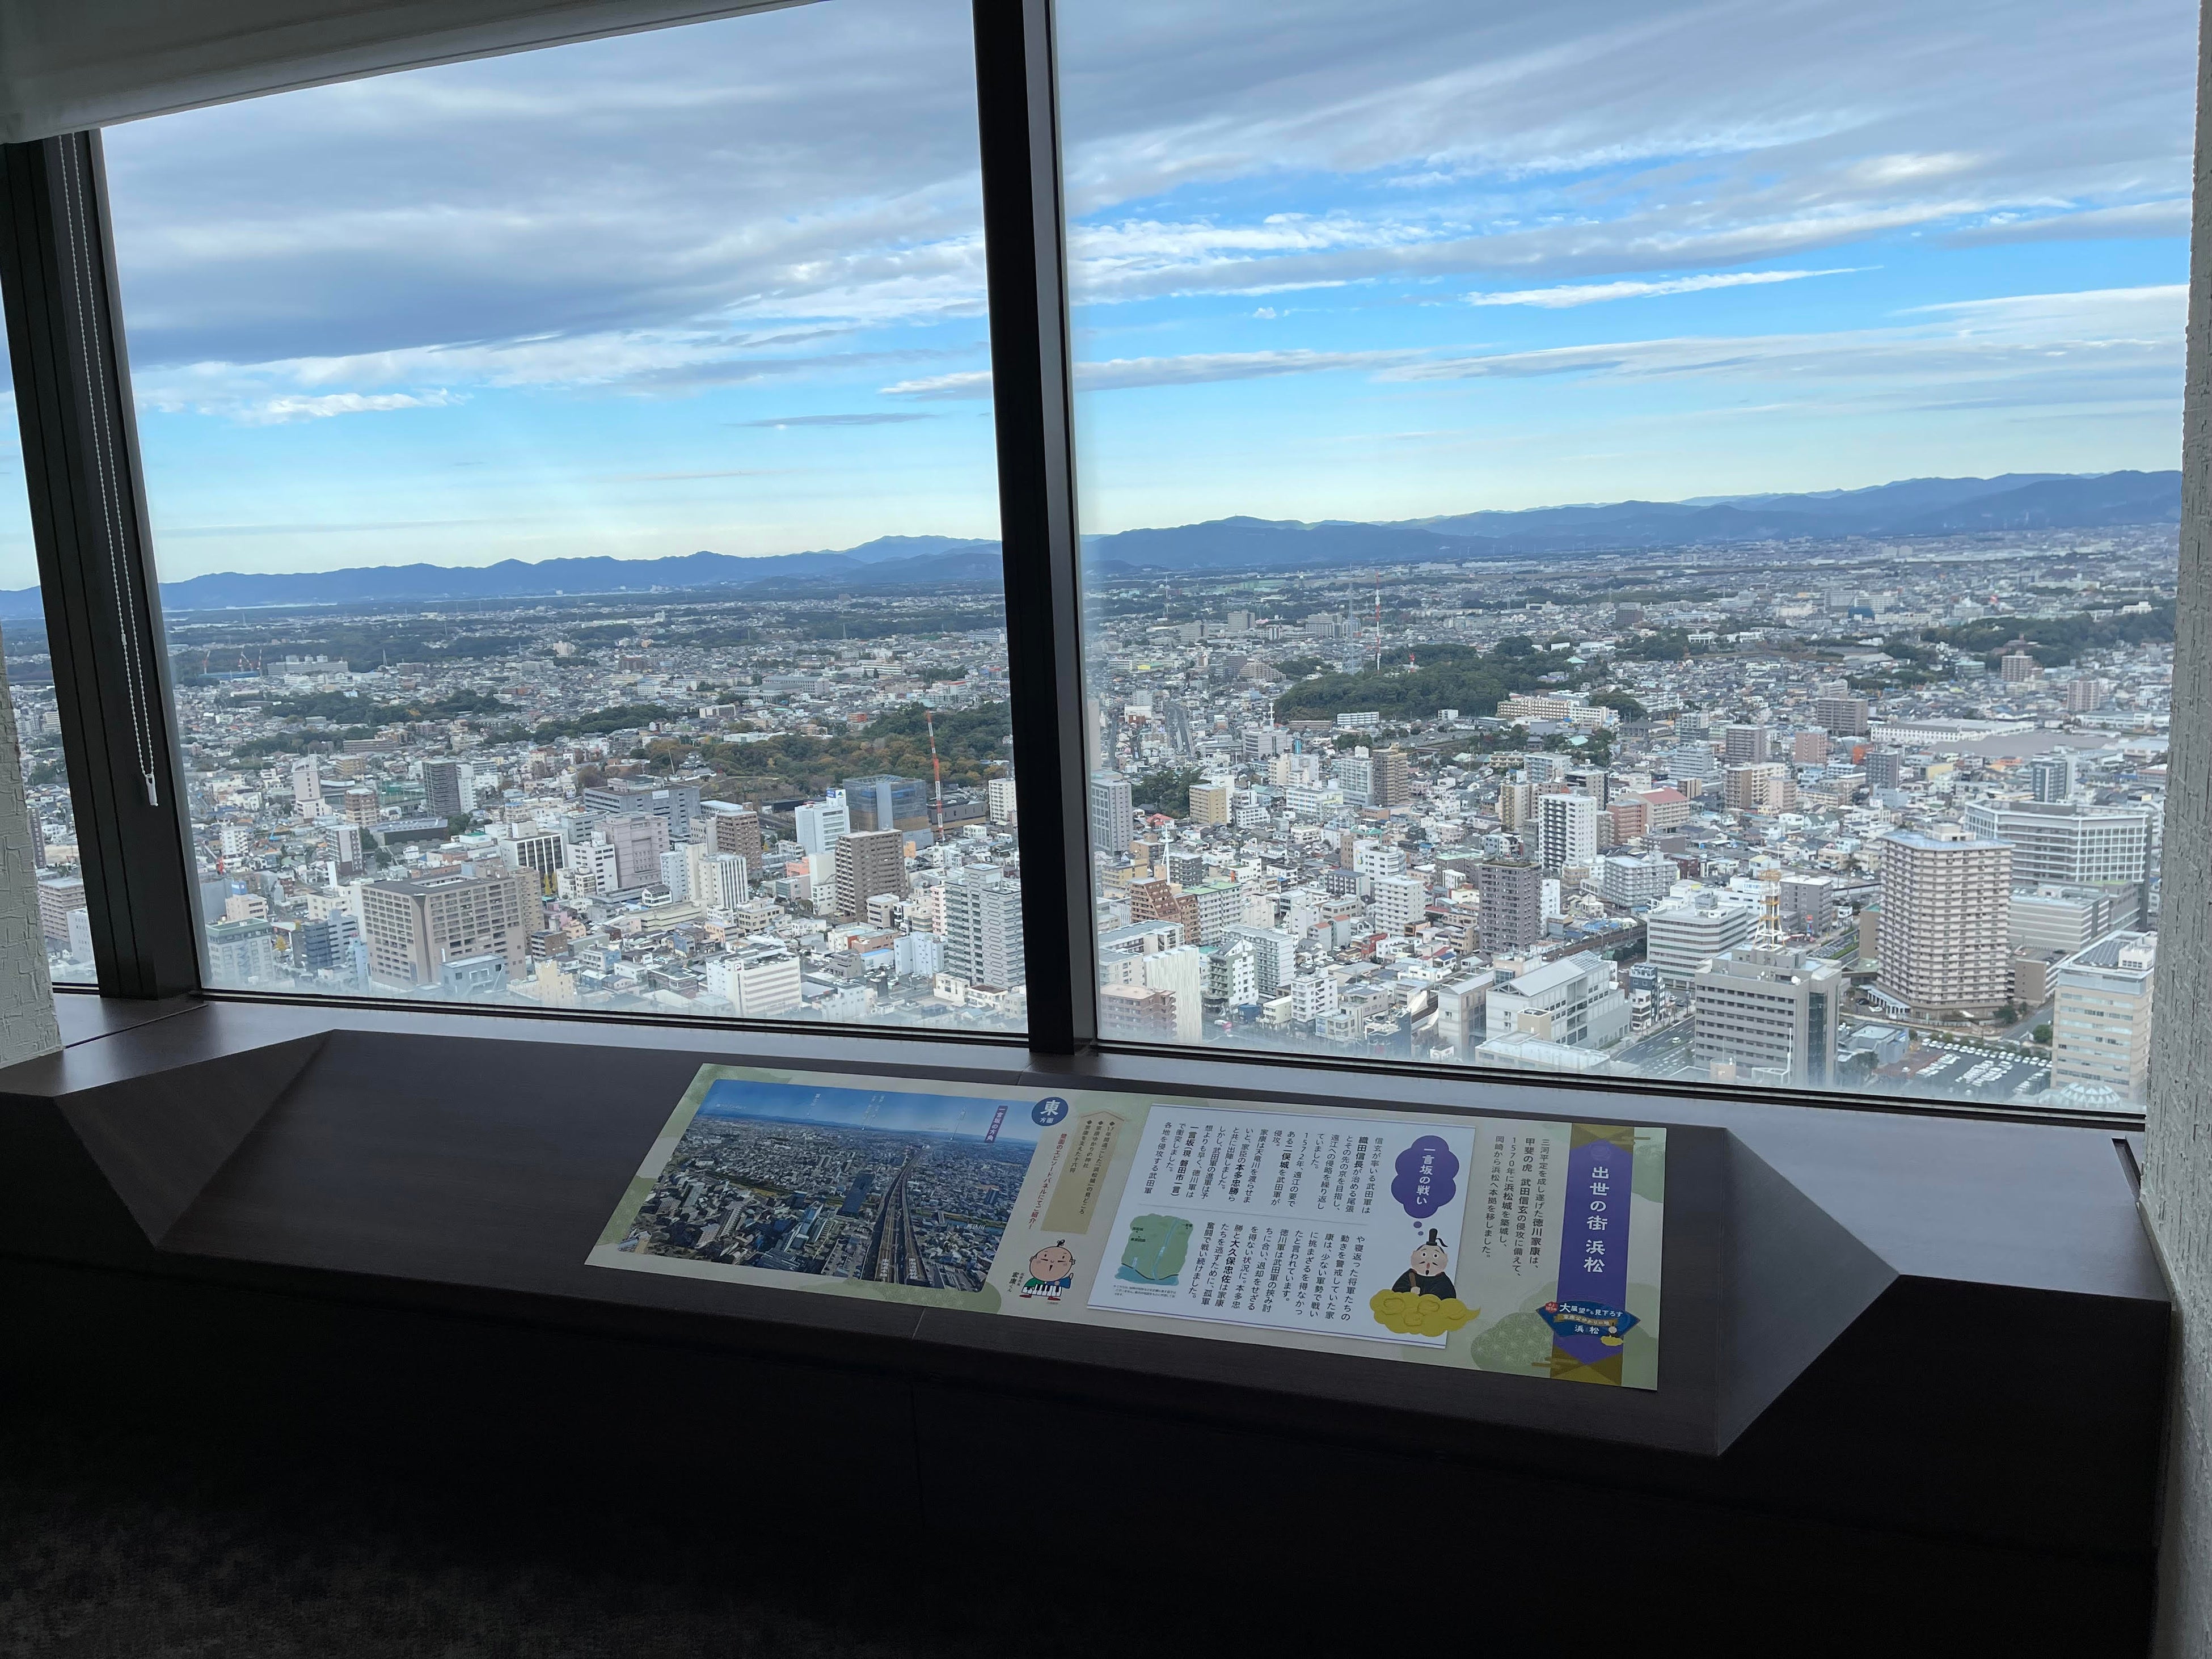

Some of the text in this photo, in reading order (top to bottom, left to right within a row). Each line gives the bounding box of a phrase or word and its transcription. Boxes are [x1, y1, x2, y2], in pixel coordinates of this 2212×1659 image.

[987, 1108, 1006, 1141] 一言坂の方角
[1040, 1100, 1061, 1116] 東
[1272, 1130, 1282, 1147] 侵攻。
[1144, 1122, 1172, 1194] 各地を侵攻する武田軍
[1166, 1124, 1186, 1172] で衝突しました。
[1186, 1125, 1213, 1198] 想よりも早く、徳川軍は
[1218, 1127, 1239, 1189] と共に出陣しました。
[1229, 1128, 1253, 1202] いと、家臣の本多忠勝ら
[1243, 1129, 1268, 1203] 家康は天竜川を渡らせま
[1271, 1131, 1295, 1206] ある二俣城を武田軍が
[1311, 1134, 1325, 1169] ていました。
[1318, 1134, 1339, 1210] 遠江への侵略を繰り返し
[1333, 1136, 1352, 1211] とその先の京を目指し、
[1345, 1137, 1368, 1213] 織田信長が治める尾張
[1362, 1137, 1383, 1214] 信玄が率いる武田軍は
[1416, 1148, 1436, 1205] 一言坂の戦い
[1482, 1136, 1505, 1258] 岡崎から浜松へ本拠を移しました。
[1529, 1139, 1550, 1268] 三河平定を成し遂げた徳川家康は、
[1583, 1167, 1610, 1273] 出世の街 浜松
[1214, 1225, 1243, 1307] 勝と大久保忠佐は家康
[1262, 1229, 1289, 1312] 徳川軍は武田軍の挟み討
[1282, 1230, 1303, 1301] たと言われています。
[1310, 1233, 1334, 1318] 康は、少ない軍勢で戦い
[1325, 1234, 1349, 1319] 動きを警戒していた家
[1341, 1236, 1365, 1321] や寝返った将軍たちの
[1575, 1325, 1599, 1334] 浜松
